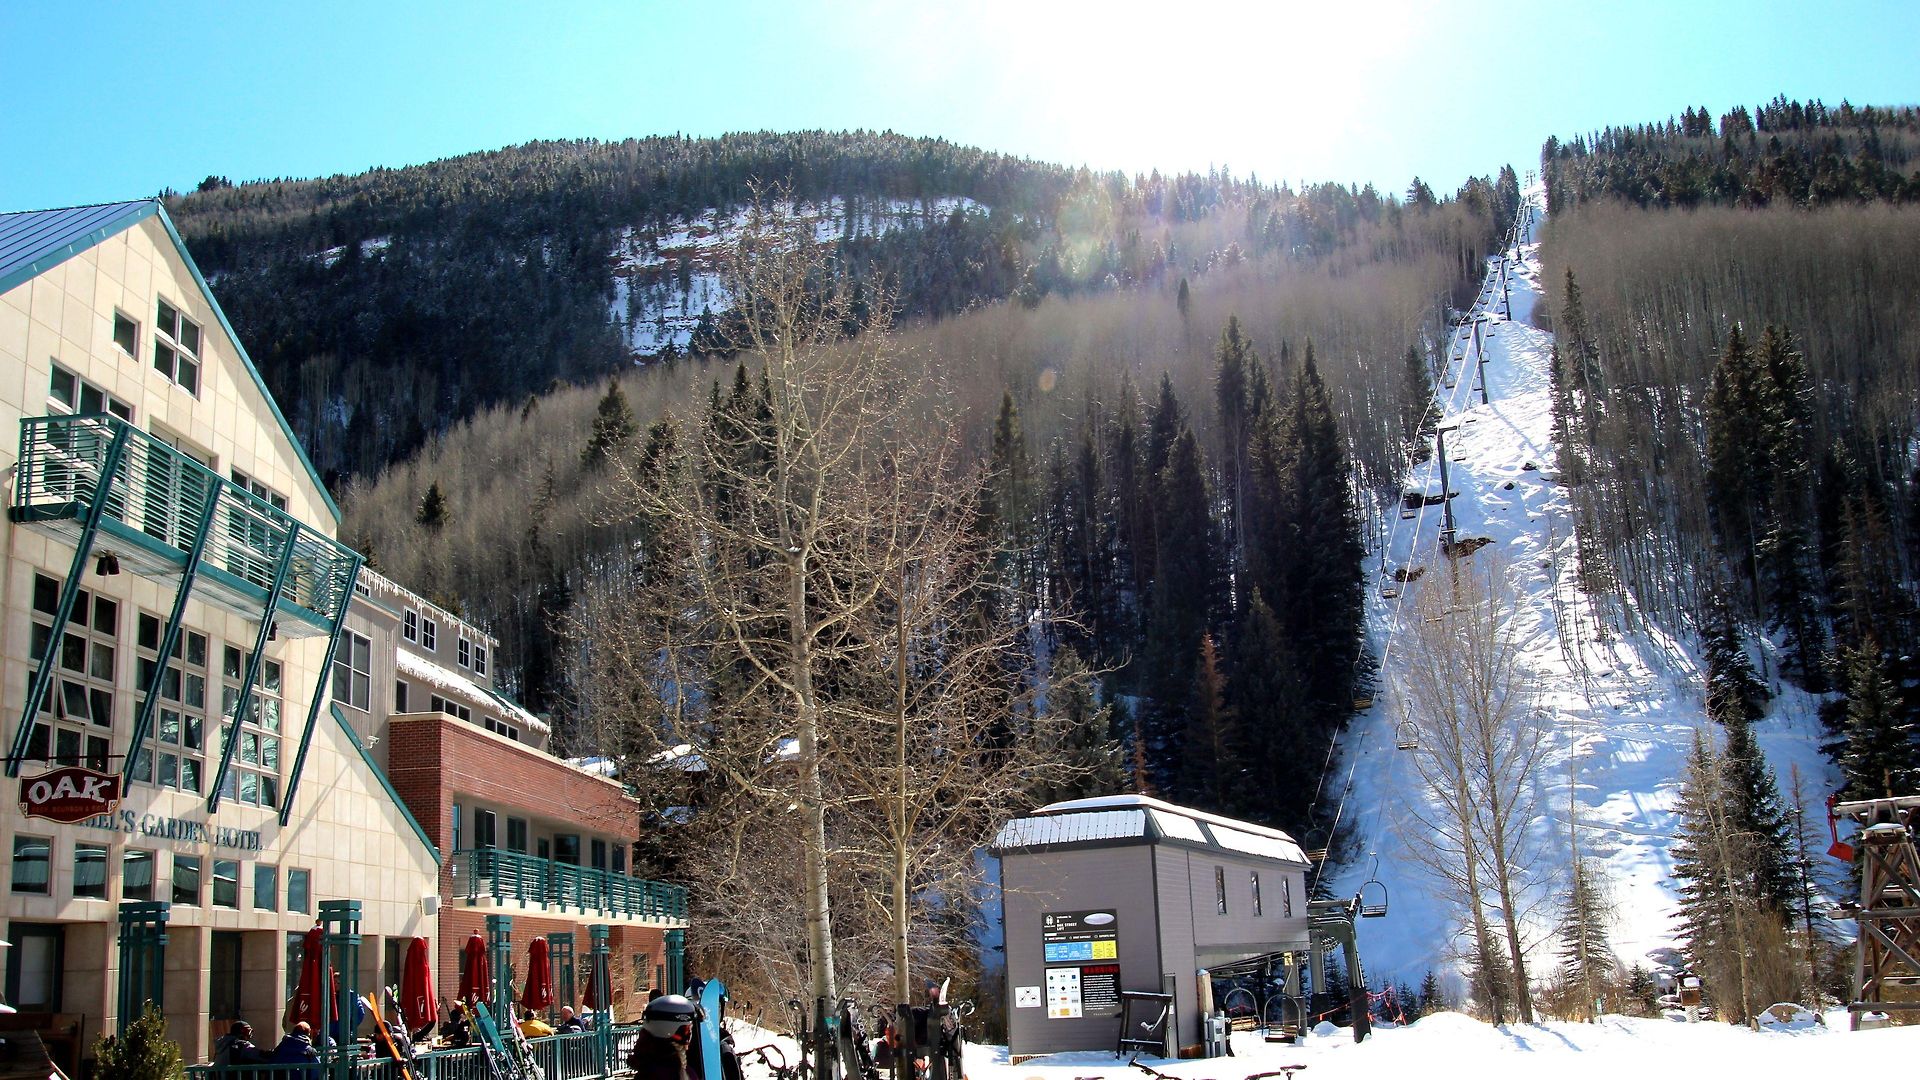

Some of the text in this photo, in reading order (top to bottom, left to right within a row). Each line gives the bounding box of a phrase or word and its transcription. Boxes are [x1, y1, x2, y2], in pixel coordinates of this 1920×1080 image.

[28, 775, 111, 804] OAK
[142, 813, 213, 843] GARDEN
[216, 826, 263, 851] HOTEL
